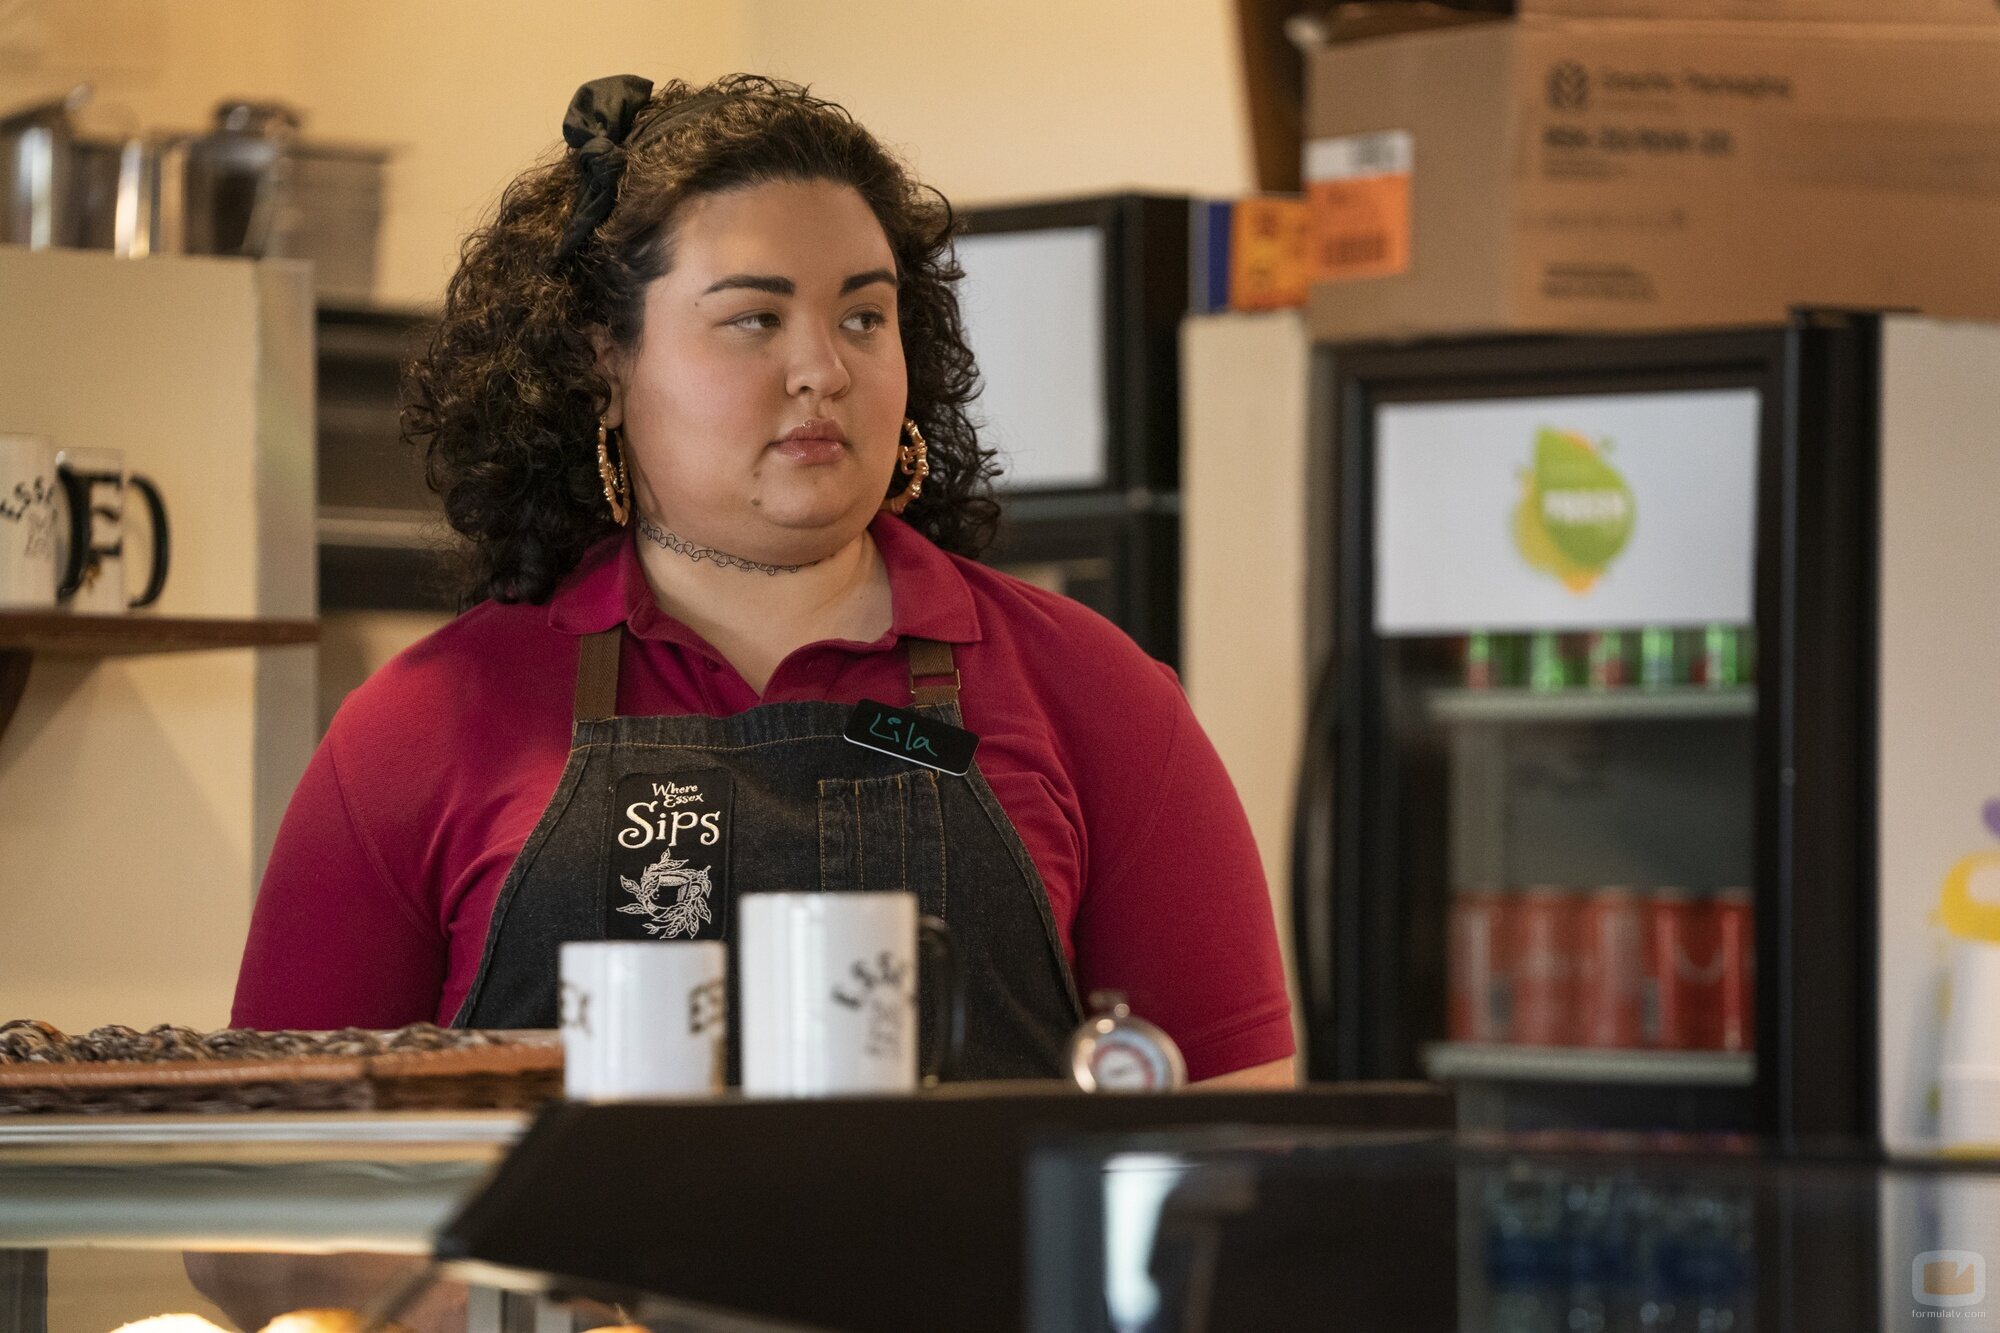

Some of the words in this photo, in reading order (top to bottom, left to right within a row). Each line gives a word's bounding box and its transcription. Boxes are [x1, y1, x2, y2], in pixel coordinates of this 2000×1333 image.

[868, 712, 939, 757] Lila
[651, 781, 698, 796] Where
[663, 793, 704, 808] Essex
[617, 800, 721, 849] Sips
